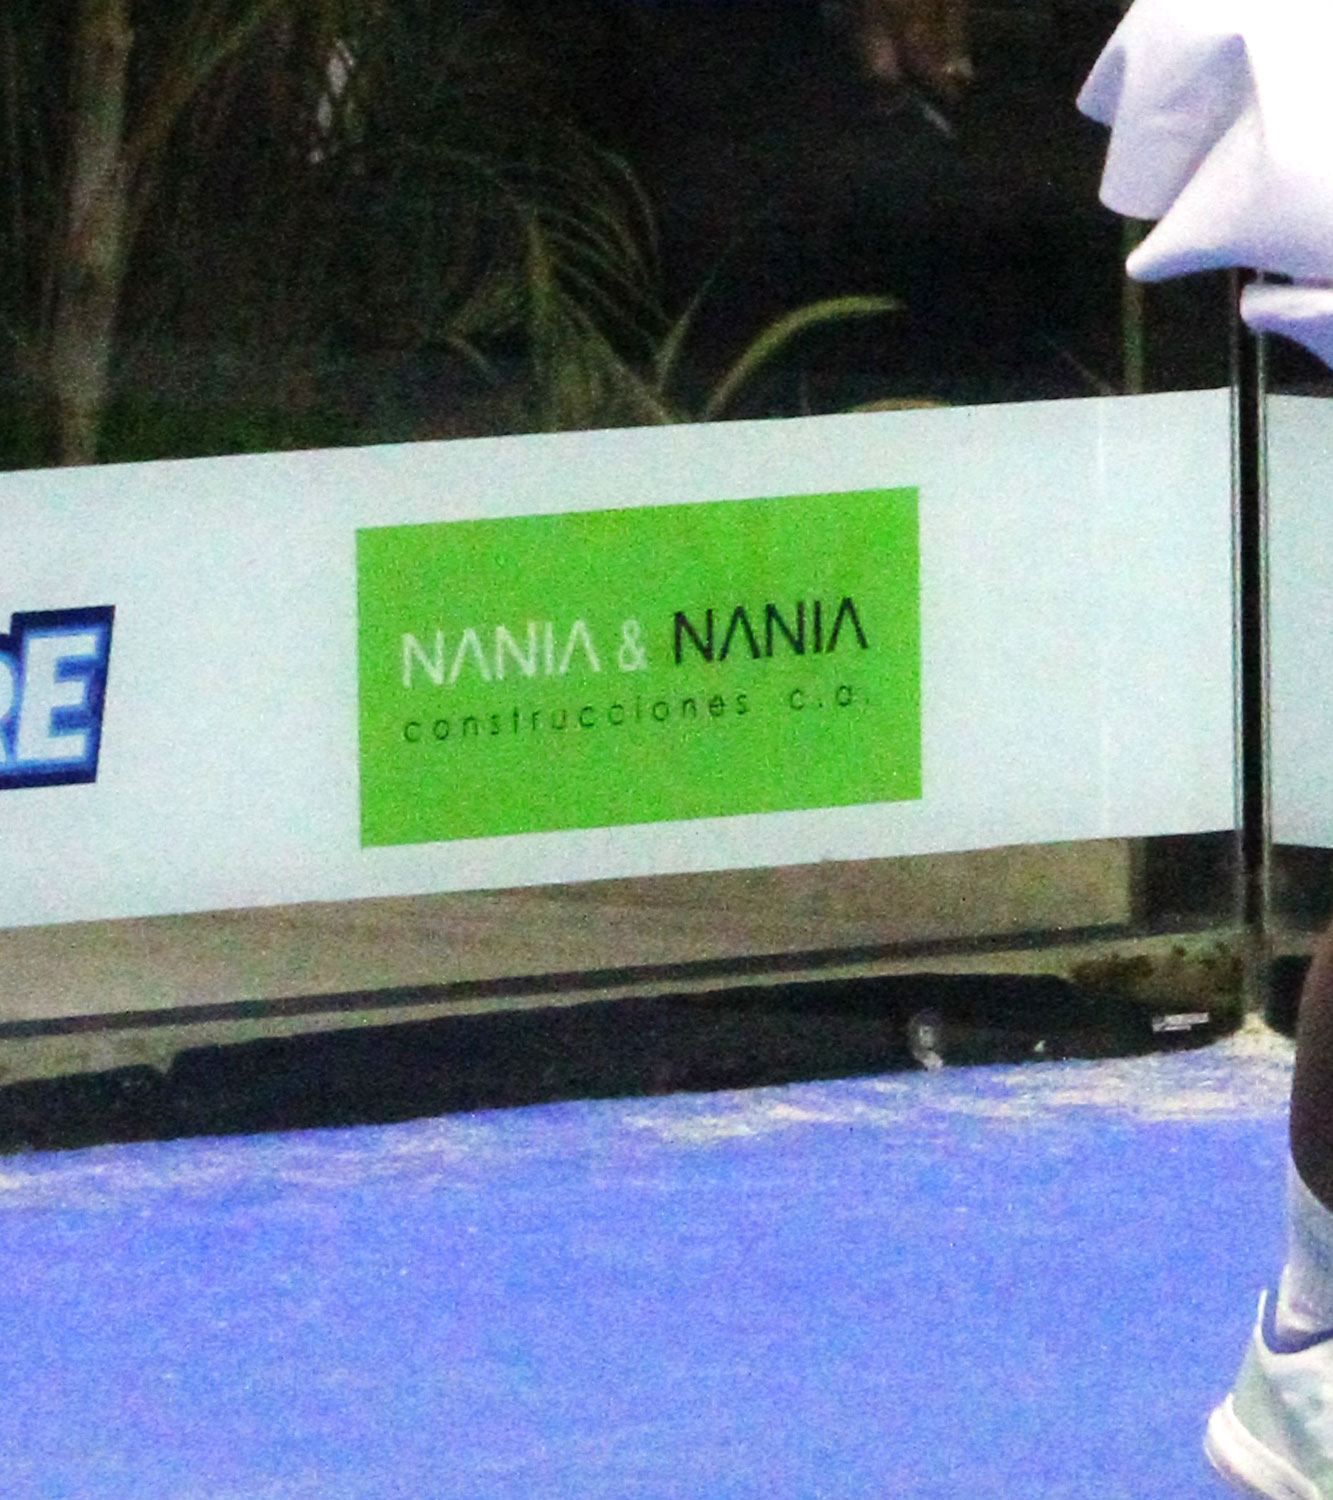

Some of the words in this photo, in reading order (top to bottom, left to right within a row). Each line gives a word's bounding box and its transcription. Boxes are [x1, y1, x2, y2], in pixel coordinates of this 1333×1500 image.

[401, 619, 601, 689] NANIA
[617, 618, 648, 672] &
[673, 596, 869, 666] NANIA
[0, 616, 108, 777] E
[403, 691, 751, 744] construcciones
